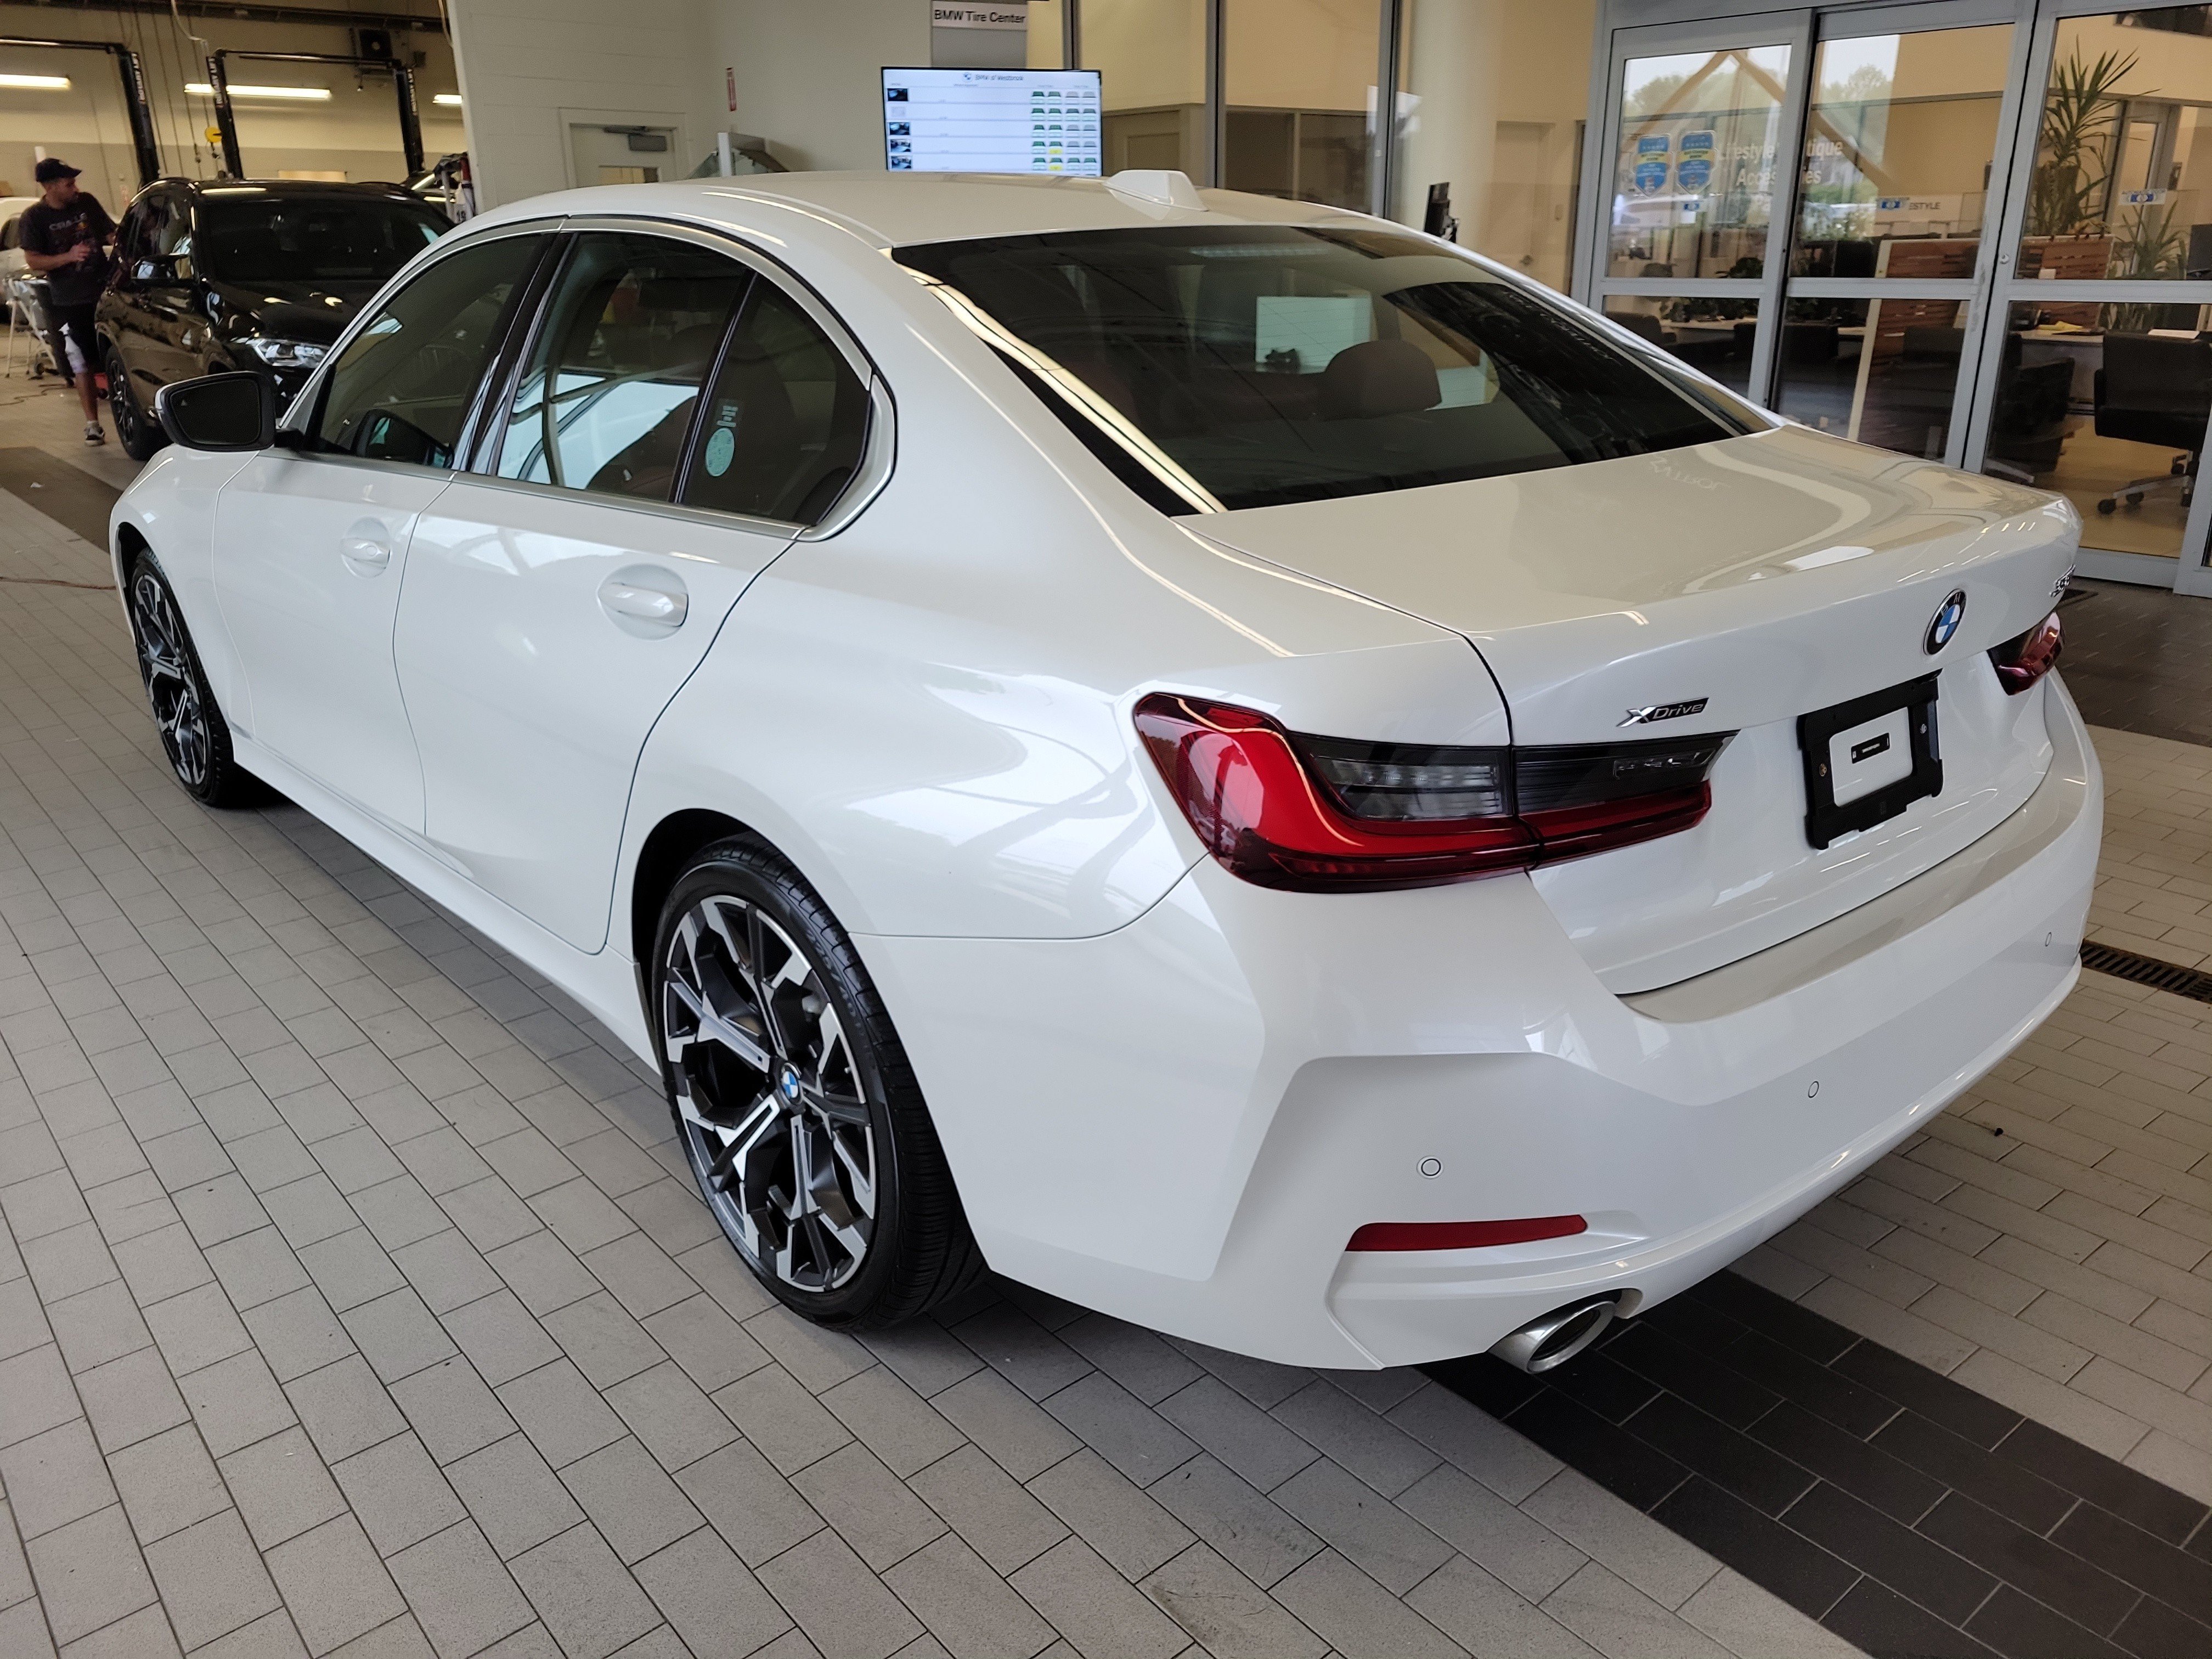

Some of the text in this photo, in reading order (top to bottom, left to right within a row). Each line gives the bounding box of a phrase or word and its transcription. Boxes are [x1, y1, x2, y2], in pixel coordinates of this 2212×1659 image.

[934, 9, 1026, 23] BMW Tire Center
